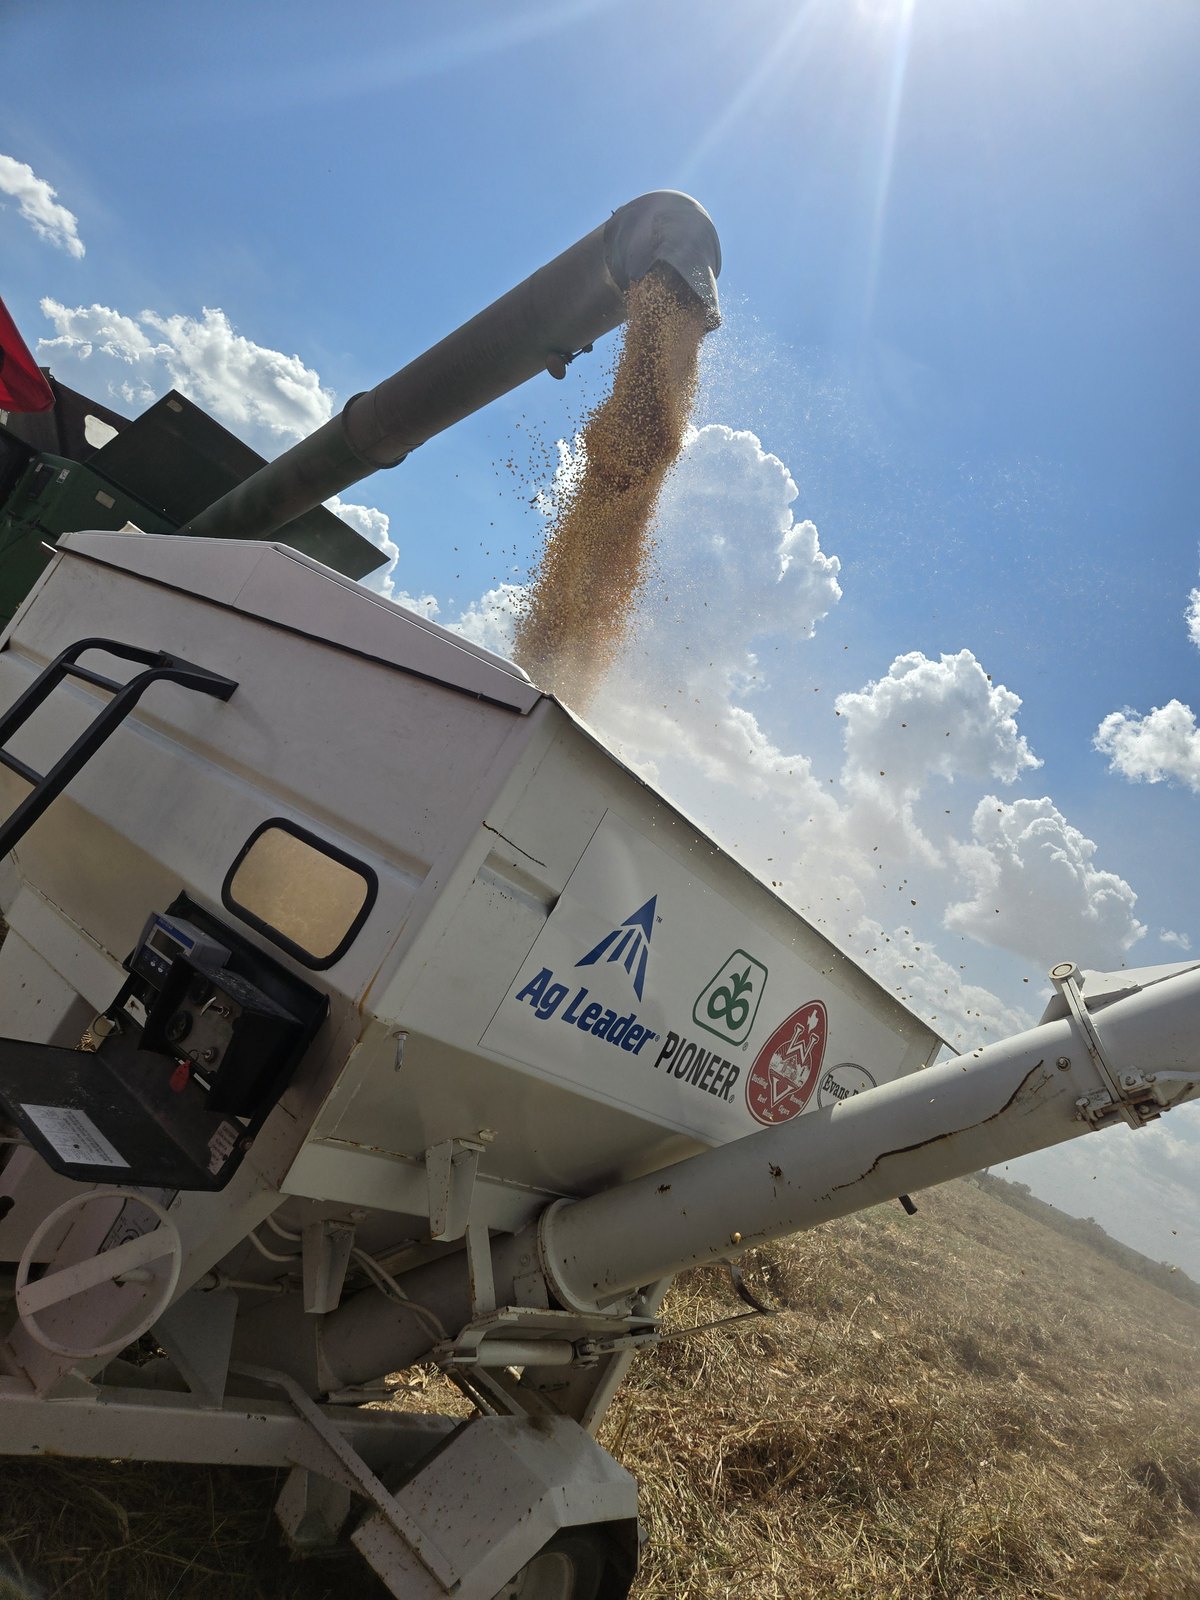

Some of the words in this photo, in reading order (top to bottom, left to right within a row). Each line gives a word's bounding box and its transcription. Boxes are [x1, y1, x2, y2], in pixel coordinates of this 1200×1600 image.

[515, 967, 569, 1020] Ag
[561, 987, 656, 1055] Leader
[654, 1031, 740, 1101] PIONEER
[822, 1074, 849, 1100] Evans
